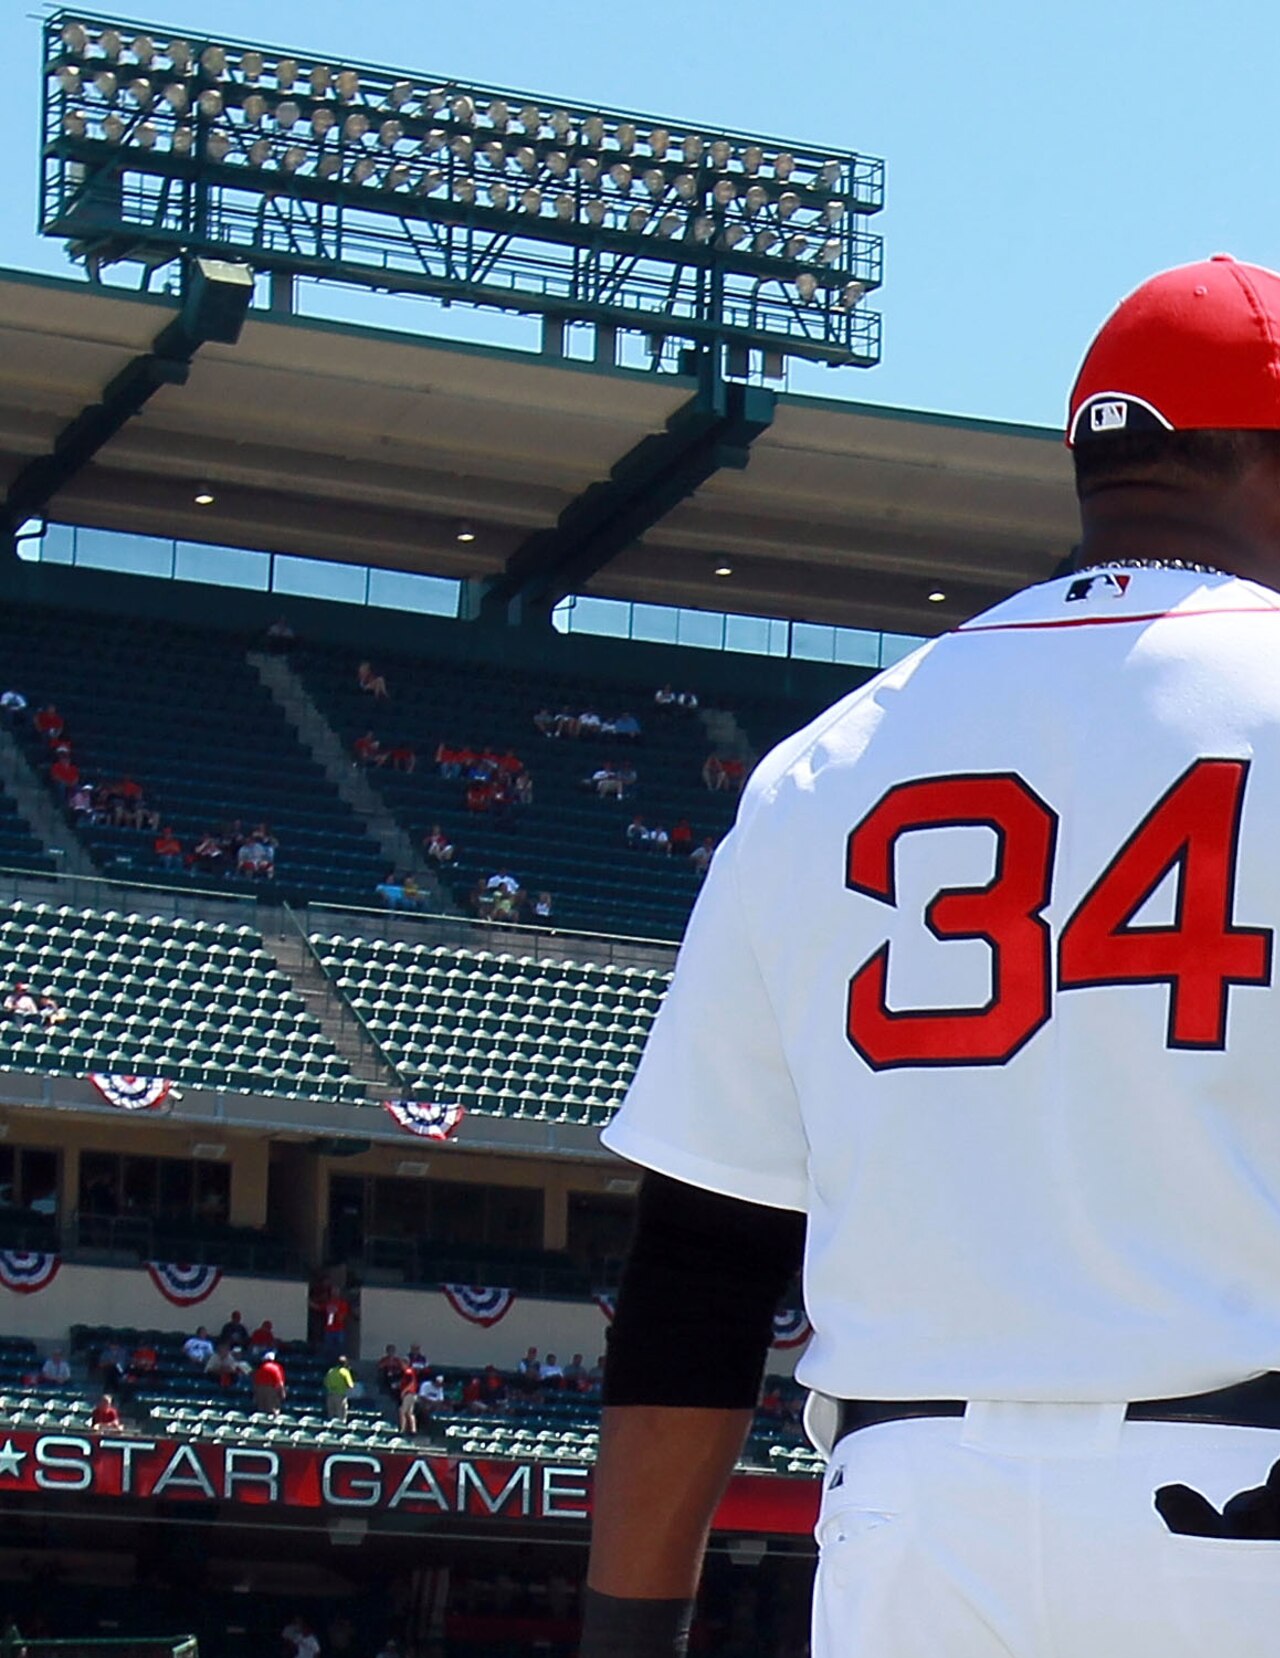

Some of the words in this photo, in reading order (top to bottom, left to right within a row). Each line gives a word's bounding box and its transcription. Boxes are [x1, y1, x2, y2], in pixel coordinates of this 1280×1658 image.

[846, 757, 1273, 1071] 34
[34, 1435, 280, 1501] STAR
[322, 1454, 590, 1519] GAME
